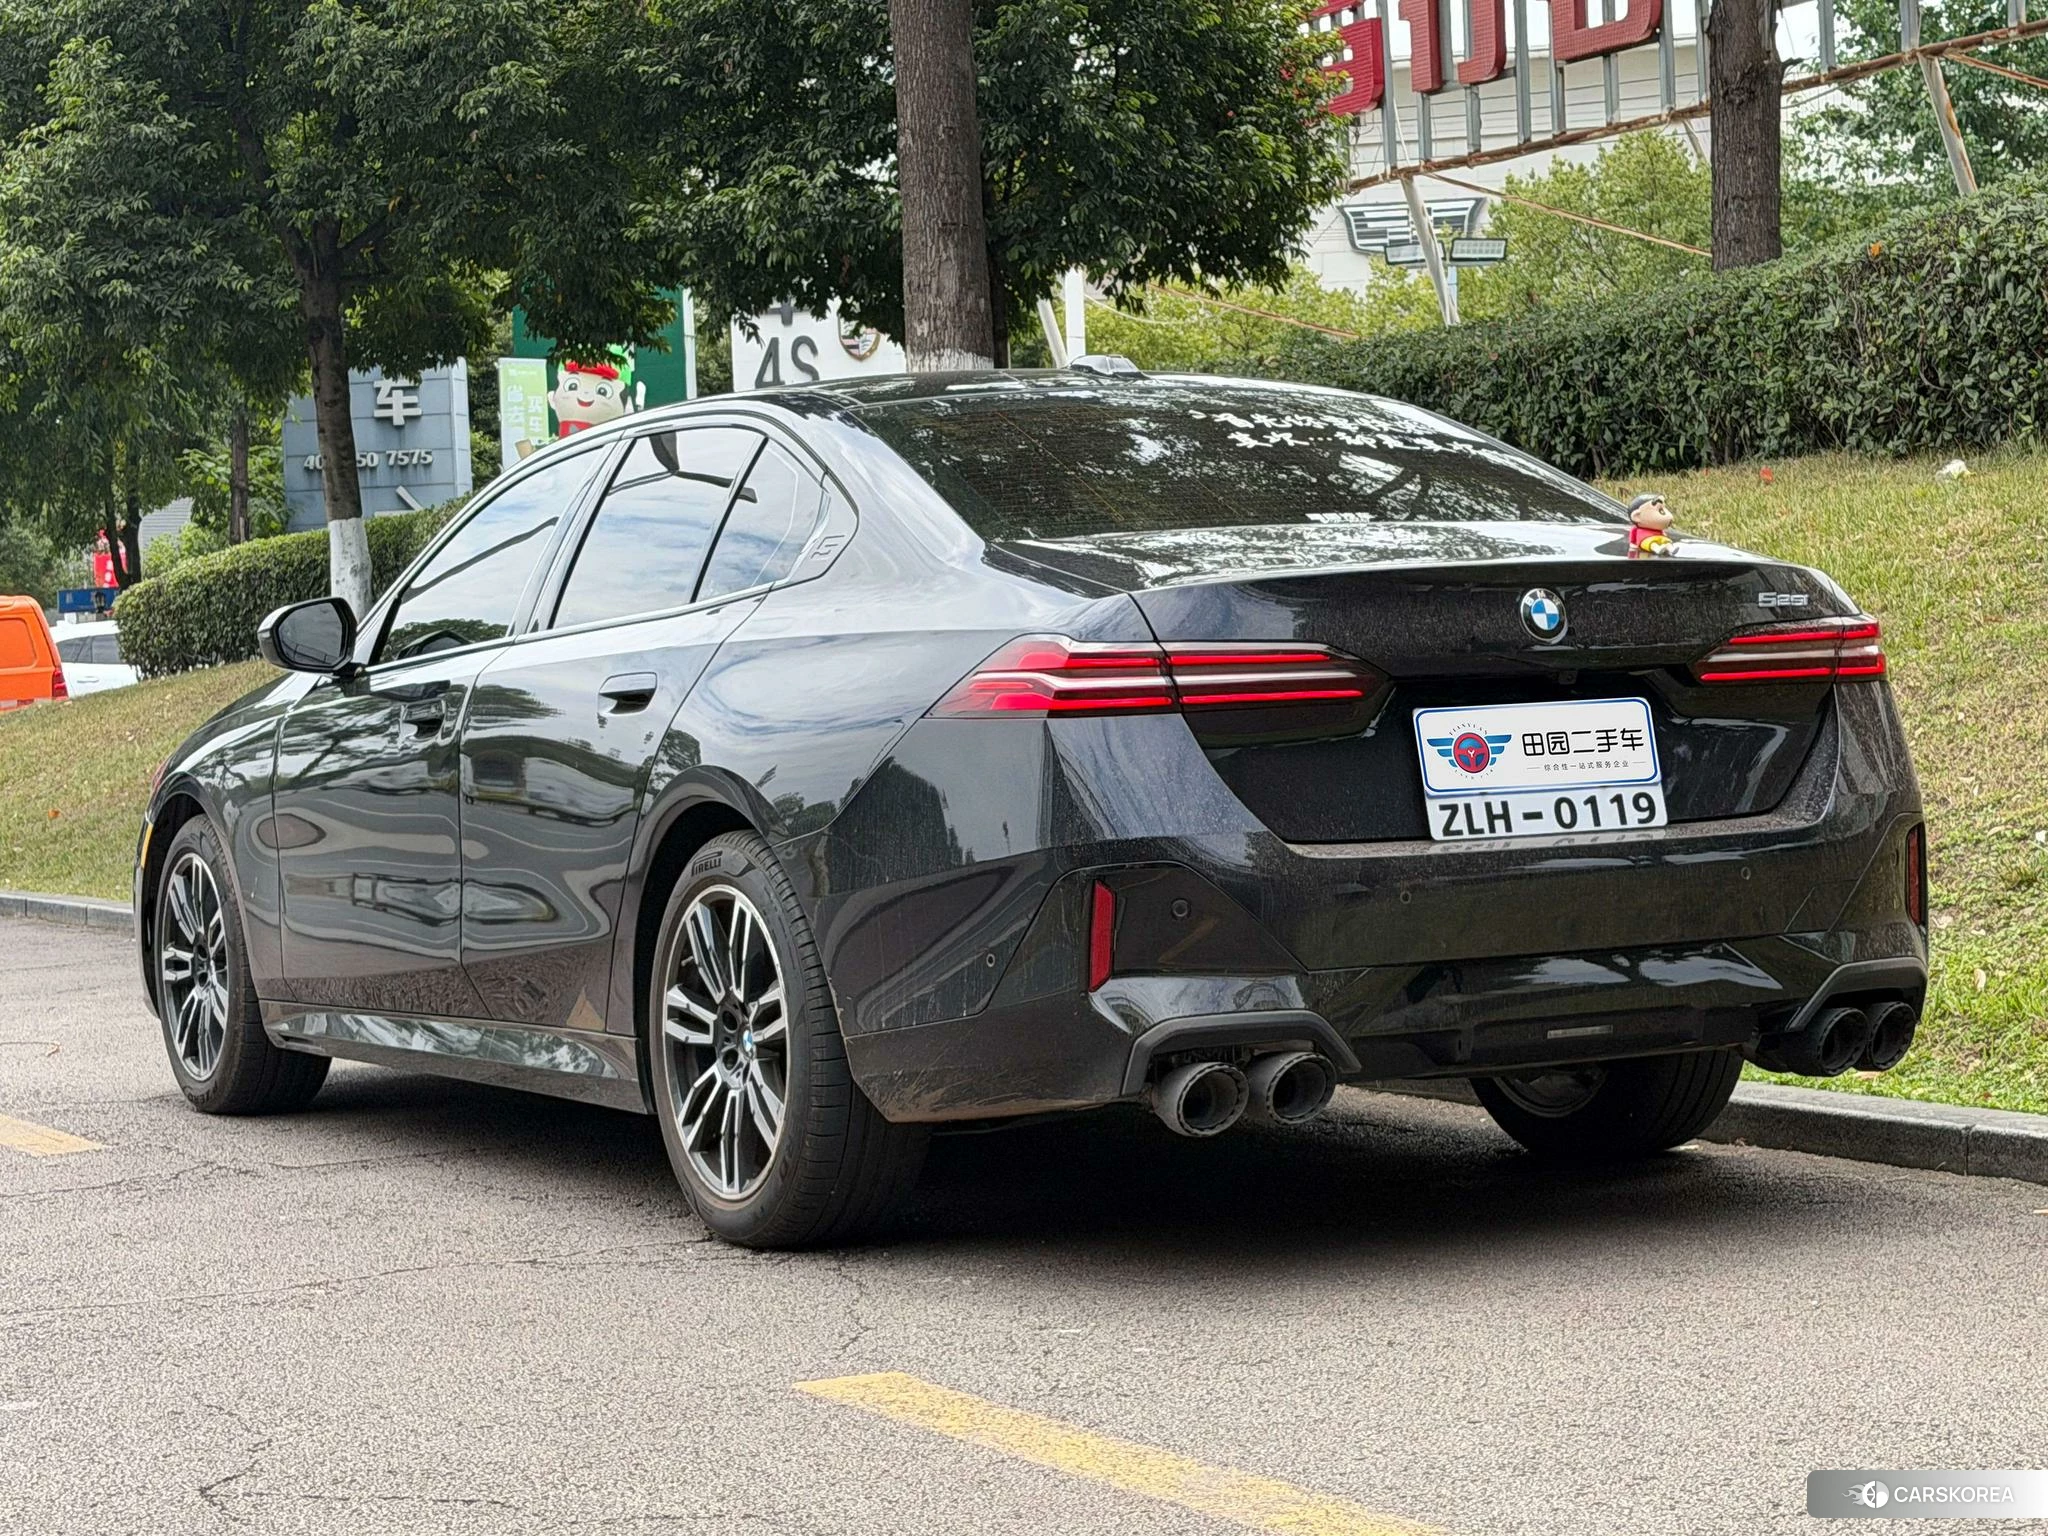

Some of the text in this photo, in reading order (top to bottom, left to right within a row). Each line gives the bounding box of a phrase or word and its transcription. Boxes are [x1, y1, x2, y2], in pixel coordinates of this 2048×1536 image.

[755, 335, 820, 388] 4S
[374, 377, 422, 426] 车
[386, 449, 433, 466] 7575
[1522, 728, 1644, 756] 田园二手车
[691, 850, 723, 877] PIRELLI
